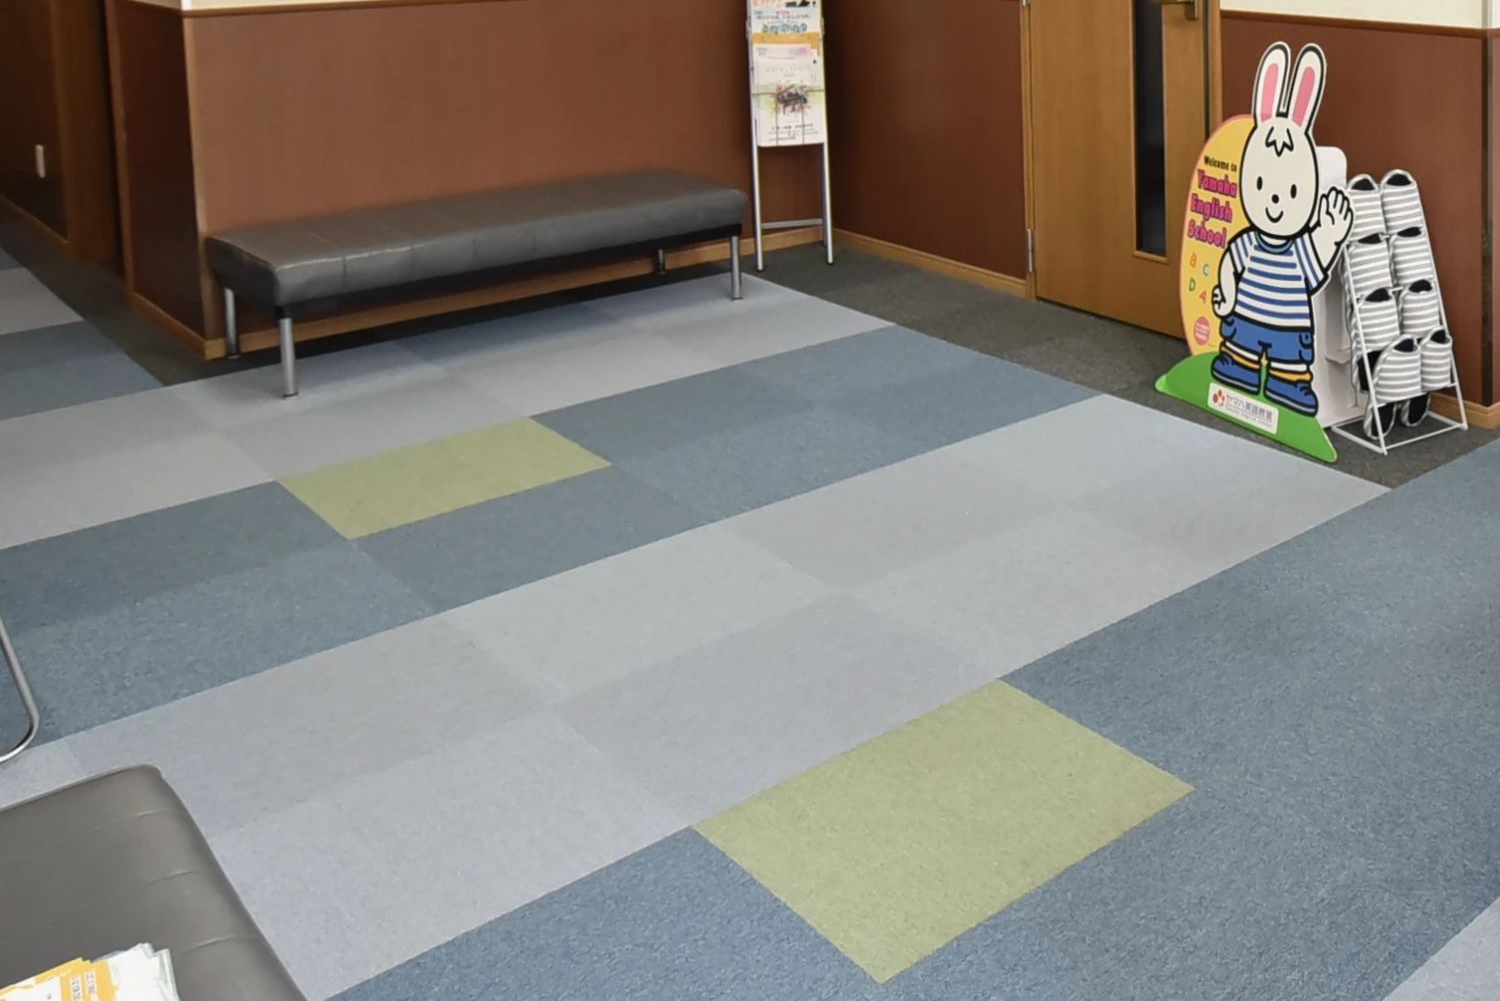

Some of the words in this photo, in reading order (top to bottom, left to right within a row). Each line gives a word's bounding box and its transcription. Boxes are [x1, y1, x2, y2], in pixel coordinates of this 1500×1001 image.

[1204, 156, 1230, 170] Welcome
[1231, 163, 1237, 172] to
[1197, 168, 1238, 198] Yamaha
[1190, 193, 1233, 223] English
[1187, 219, 1227, 249] School
[1202, 264, 1210, 276] C
[1188, 278, 1196, 292] D
